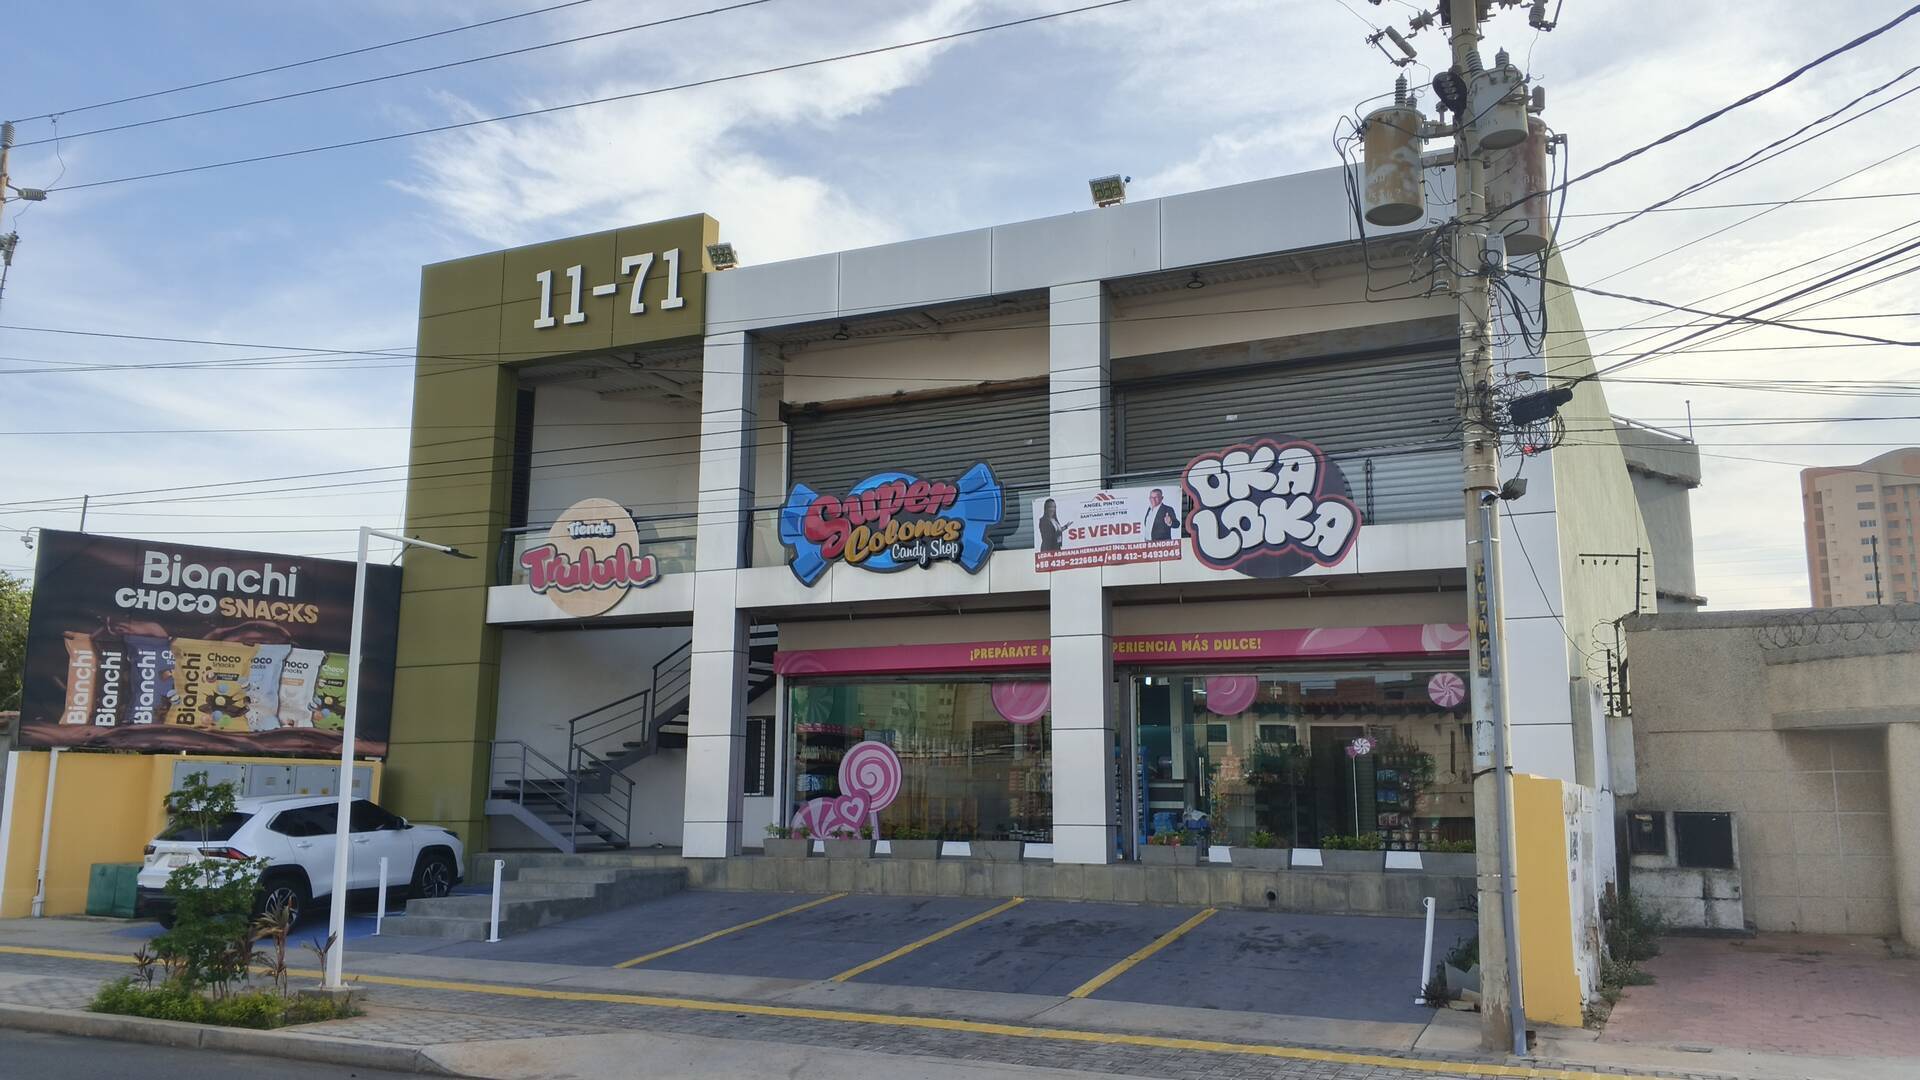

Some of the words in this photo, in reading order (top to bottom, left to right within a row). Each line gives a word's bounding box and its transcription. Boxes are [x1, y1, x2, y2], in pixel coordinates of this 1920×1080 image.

[533, 247, 684, 329] 11-71
[1188, 446, 1317, 507] OKA
[568, 520, 615, 539] Tienda
[805, 480, 957, 559] Super
[1068, 527, 1085, 540] SE
[1088, 522, 1141, 537] VENDE
[1193, 495, 1354, 559] LOKA
[143, 550, 297, 598] Bianchi
[521, 545, 657, 593] Trululu
[892, 541, 926, 564] Candy
[930, 539, 958, 558] Shop
[115, 587, 217, 615] CHOCO
[219, 597, 319, 624] SNACKS
[207, 652, 241, 663] Choco
[284, 661, 309, 669] hoco
[322, 665, 345, 674] Choco
[970, 642, 1037, 661] ¡PREPÁRATE
[1112, 640, 1176, 653] PERIENCIA
[1182, 634, 1208, 650] MÁS
[1214, 638, 1261, 650] DULCE!
[67, 650, 93, 725] Bianchi
[95, 651, 122, 727] Bianchi
[134, 650, 156, 725] Bianchi
[176, 652, 202, 725] Bianchi
